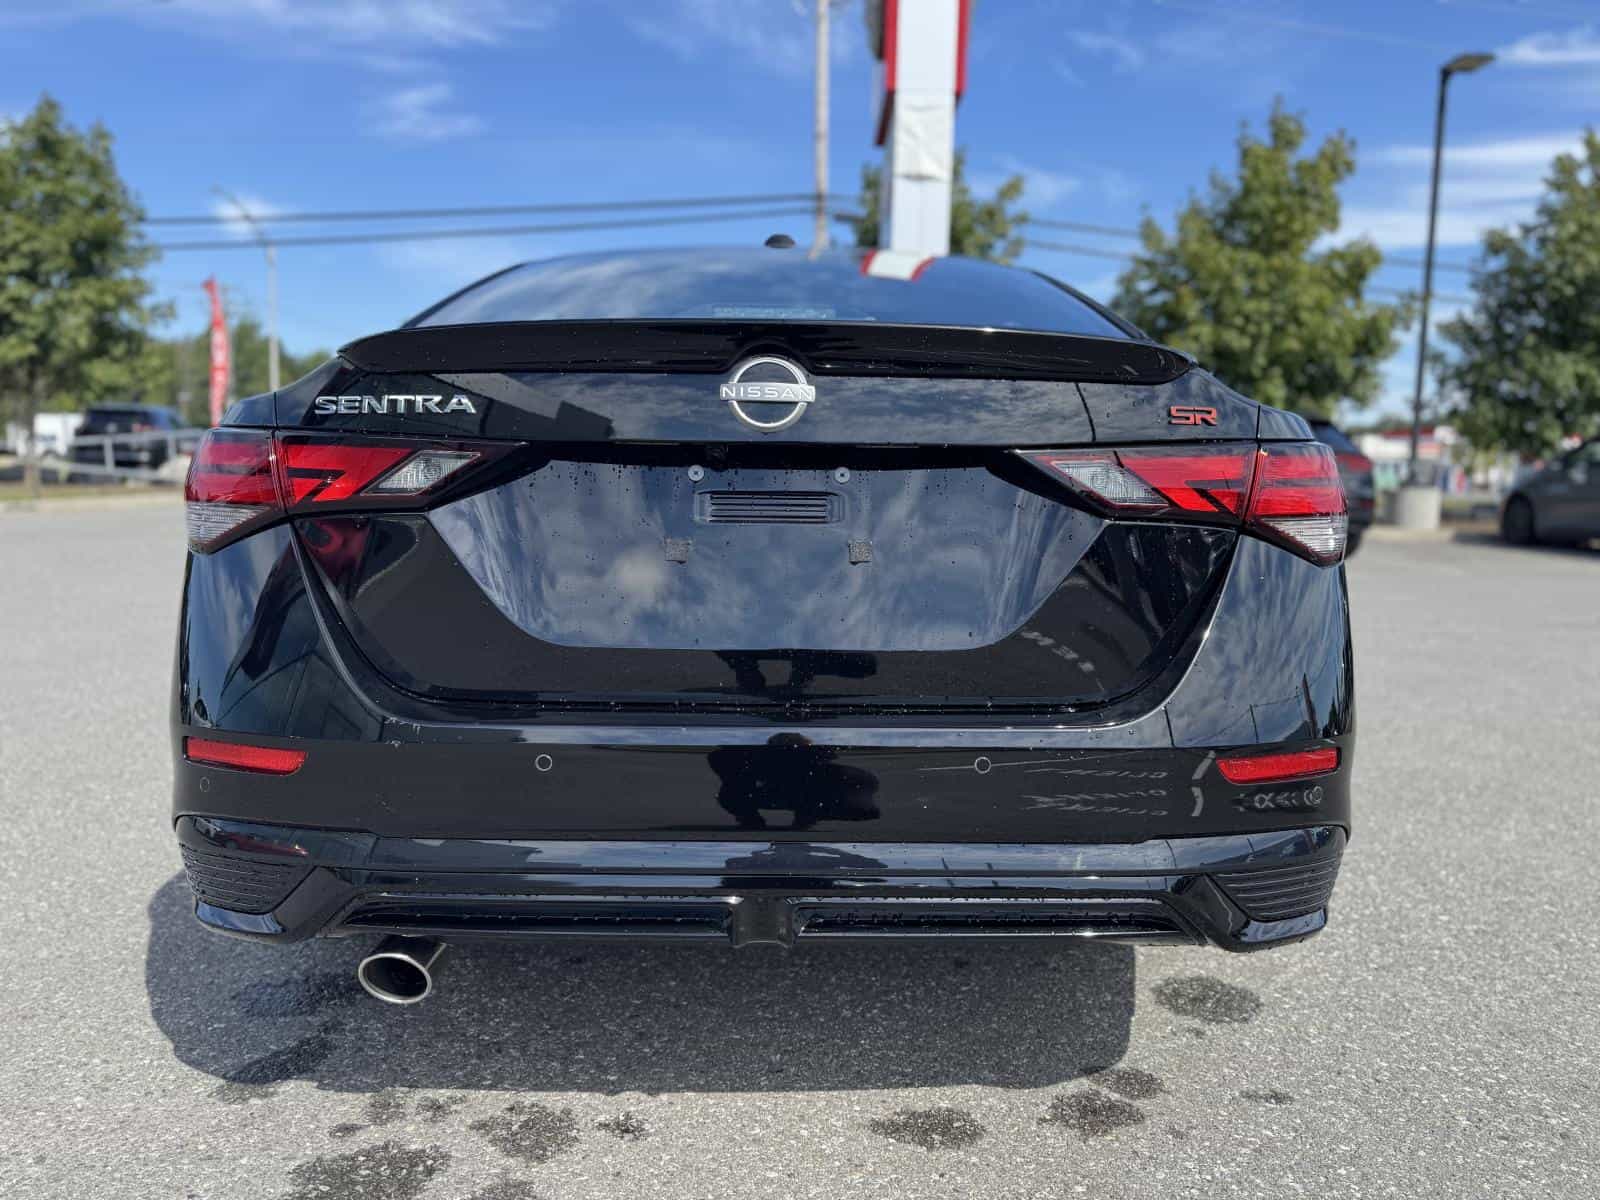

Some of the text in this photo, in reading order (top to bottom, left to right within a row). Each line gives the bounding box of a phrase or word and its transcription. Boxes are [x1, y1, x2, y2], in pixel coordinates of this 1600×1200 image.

[721, 385, 813, 401] NISSAN
[314, 394, 477, 415] SENTRA
[1169, 405, 1218, 426] SR
